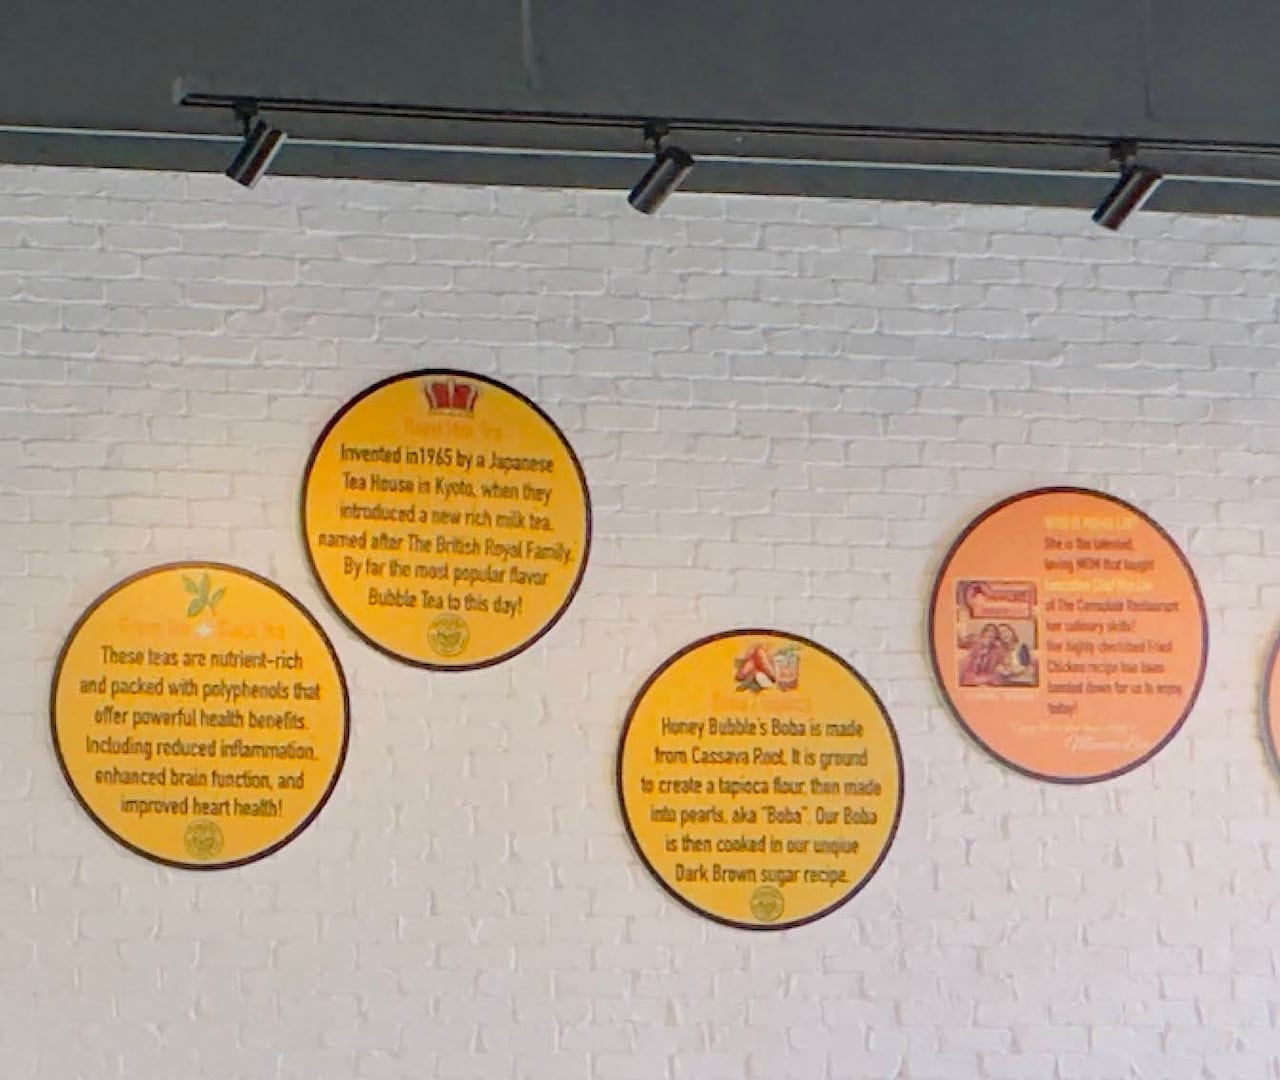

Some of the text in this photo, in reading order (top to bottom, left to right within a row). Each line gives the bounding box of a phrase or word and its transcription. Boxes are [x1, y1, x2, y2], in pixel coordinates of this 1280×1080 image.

[341, 443, 401, 463] Invented
[456, 452, 472, 471] by
[476, 456, 485, 468] a
[489, 453, 554, 474] Japanese
[343, 473, 366, 489] Tea
[370, 474, 413, 492] House
[418, 477, 430, 492] in
[481, 483, 519, 499] when
[523, 481, 551, 506] they
[340, 504, 414, 523] introduced
[419, 510, 427, 523] a
[431, 512, 460, 525] new
[464, 509, 491, 526] rich
[496, 511, 524, 529] milk
[319, 532, 367, 548] named
[371, 533, 403, 550] after
[408, 534, 431, 551] The
[436, 535, 479, 554] British
[485, 538, 522, 560] Royal
[343, 557, 549, 585] By far the most popular flavor
[368, 588, 523, 618] Bubble Tea to this day!
[101, 645, 303, 669] These teas are nutrient-rich
[80, 677, 320, 702] and packed with polyphenols that
[94, 707, 127, 725] offer
[132, 709, 197, 729] powerful
[200, 710, 244, 728] health
[662, 717, 863, 738] Honey Bubble's Boba is made
[86, 736, 152, 760] Including
[156, 739, 216, 758] reduced
[655, 747, 687, 765] from
[691, 747, 749, 765] Cassava
[792, 749, 800, 764] It
[804, 749, 816, 766] is
[820, 749, 868, 769] ground
[95, 767, 166, 785] enhanced
[170, 769, 207, 786] brain
[277, 773, 304, 789] and
[641, 776, 654, 792] to
[658, 778, 702, 793] create
[706, 780, 714, 792] a
[719, 778, 768, 798] tapioca
[810, 779, 840, 794] then
[844, 780, 881, 795] made
[120, 798, 282, 818] improved heart health!
[651, 806, 677, 822] into
[732, 807, 756, 822] aka
[816, 807, 838, 823] Our
[844, 807, 877, 824] Boba
[665, 835, 859, 858] is then cooked in our unique
[675, 865, 708, 882] Dark
[713, 865, 756, 883] Brown
[760, 868, 800, 887] sugar
